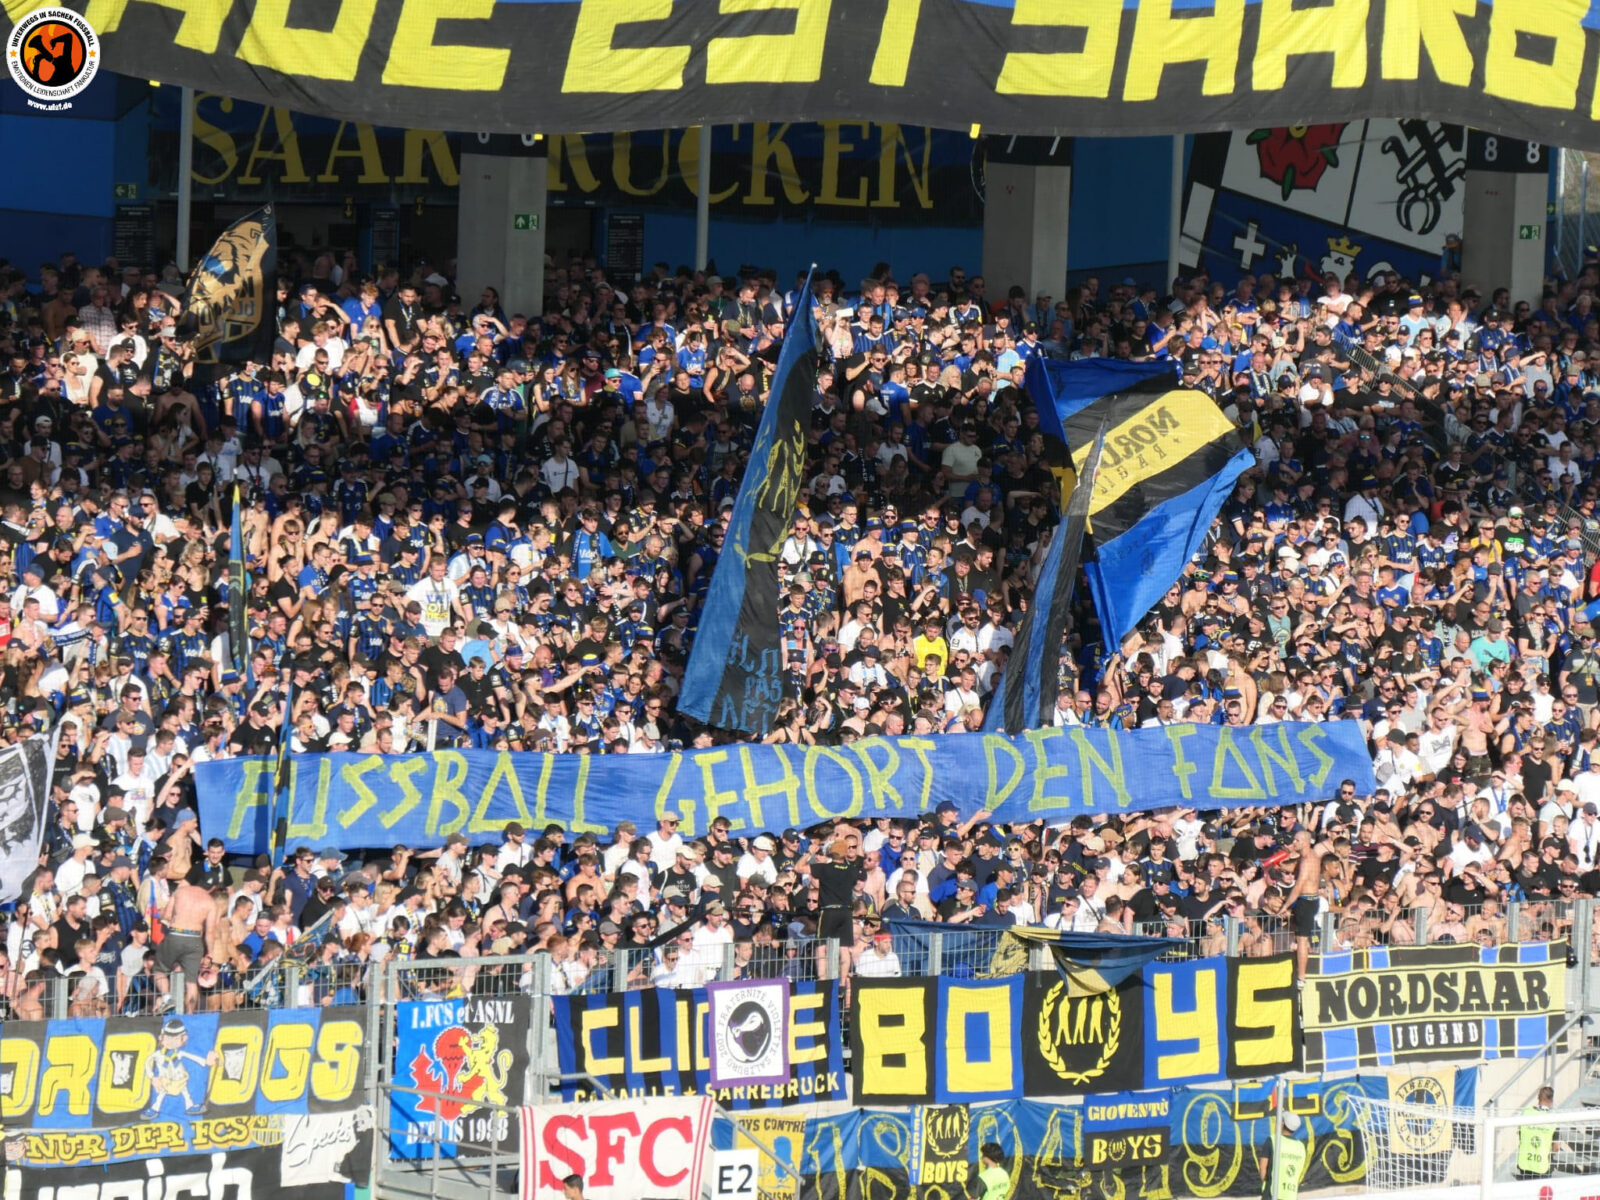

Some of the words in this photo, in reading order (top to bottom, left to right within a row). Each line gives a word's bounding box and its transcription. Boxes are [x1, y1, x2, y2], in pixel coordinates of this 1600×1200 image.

[1484, 136, 1498, 162] 8
[1526, 140, 1541, 164] 8
[227, 748, 609, 841] FUSSBALL
[981, 725, 1133, 812] DEN
[1166, 722, 1336, 799] FANS
[1315, 970, 1551, 1024] NORDSAAR
[411, 1002, 454, 1029] 1.FCS
[473, 1000, 515, 1025] ASNL
[581, 992, 828, 1077] CLIE
[1395, 1022, 1480, 1048] JUGEND
[705, 1071, 840, 1102] SARREBRUCK
[24, 1131, 107, 1163] NUR
[112, 1121, 187, 1153] DER
[190, 1114, 253, 1147] FCS
[763, 1117, 807, 1133] CONTRE
[539, 1110, 694, 1191] SFC
[717, 1163, 753, 1195] E2
[923, 1160, 969, 1184] BOYS
